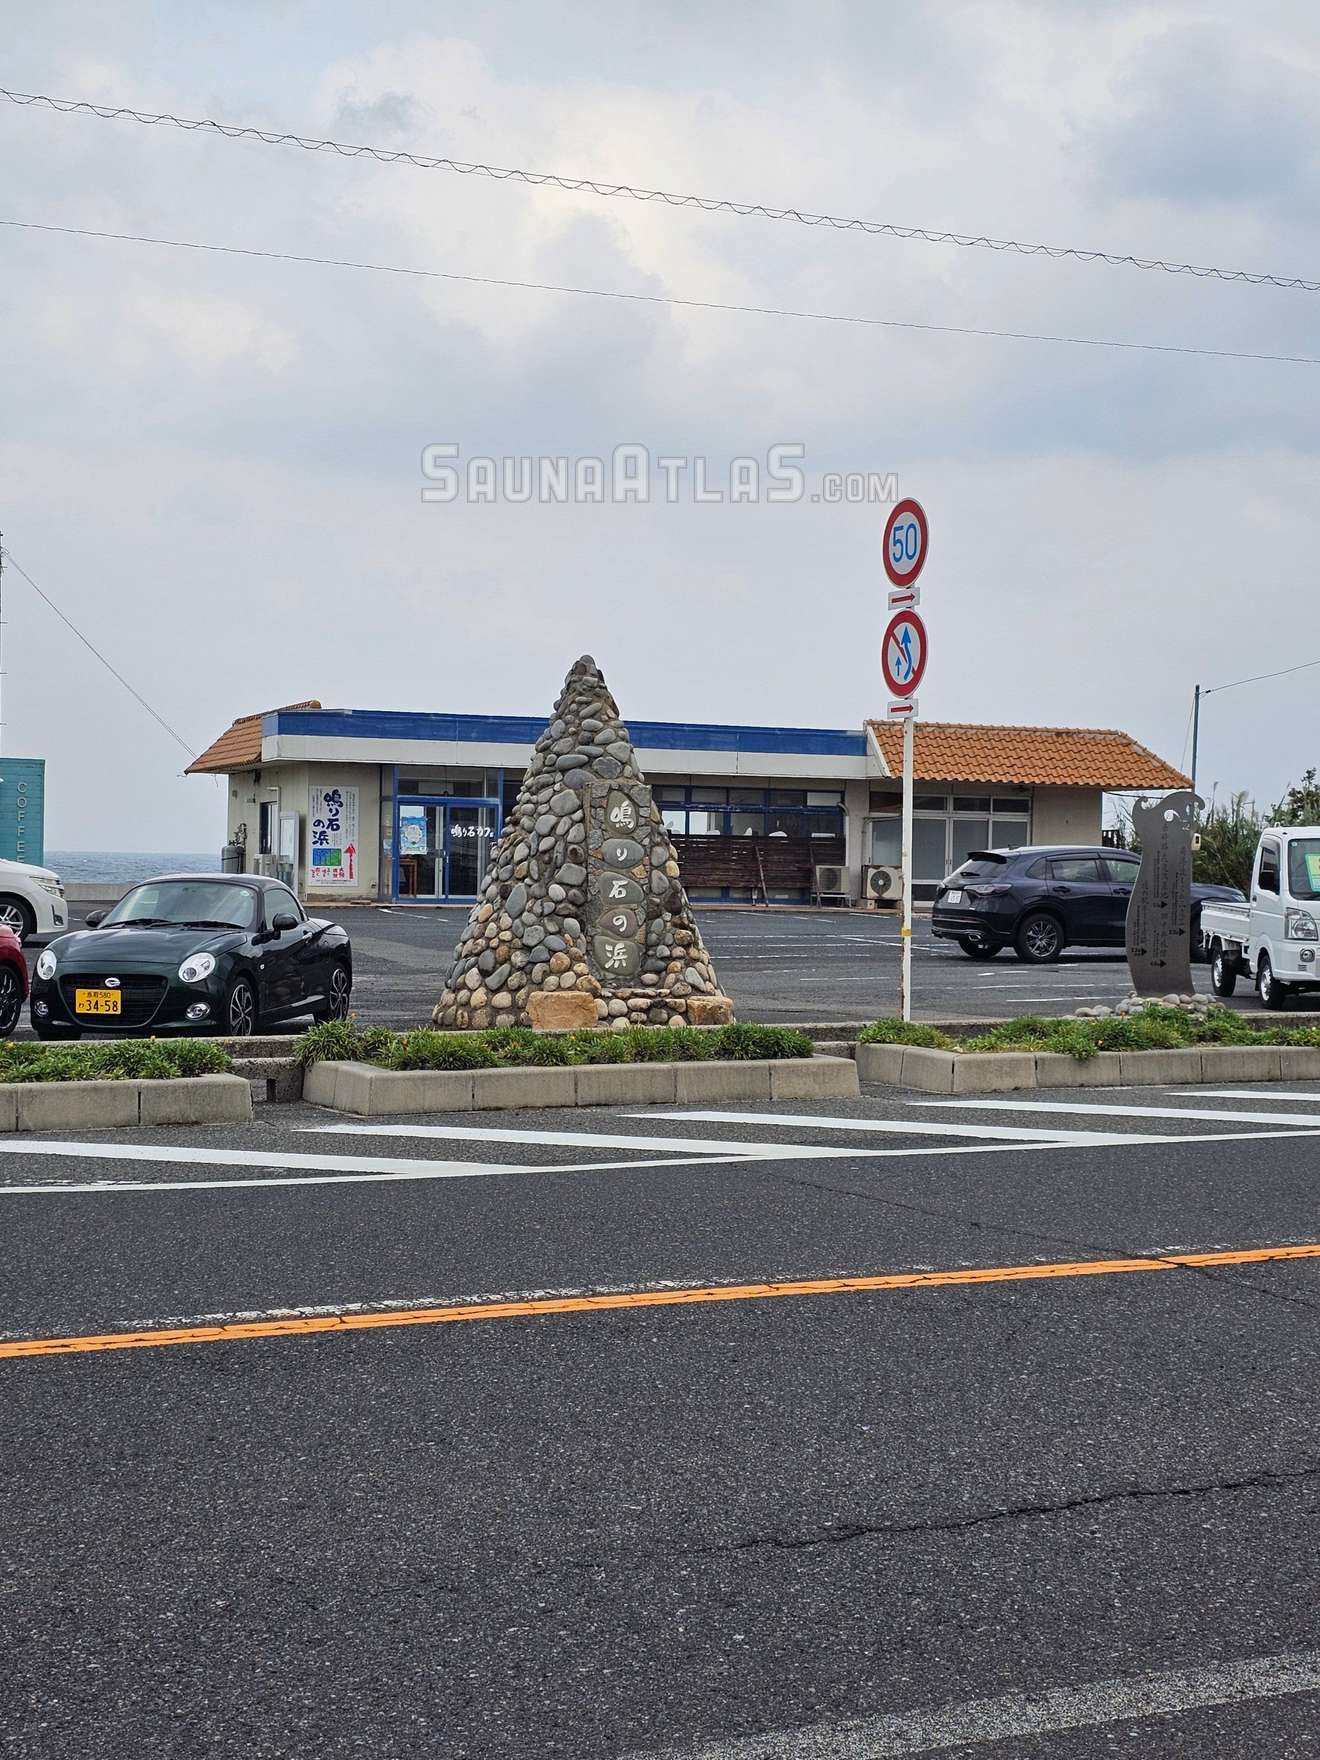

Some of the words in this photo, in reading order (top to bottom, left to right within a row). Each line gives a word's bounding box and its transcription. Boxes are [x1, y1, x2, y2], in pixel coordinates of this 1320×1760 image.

[892, 523, 918, 563] 50
[450, 824, 495, 838] 鳴り石カフェ
[604, 800, 635, 969] 鳴り石の浜
[86, 999, 119, 1012] 34-58
